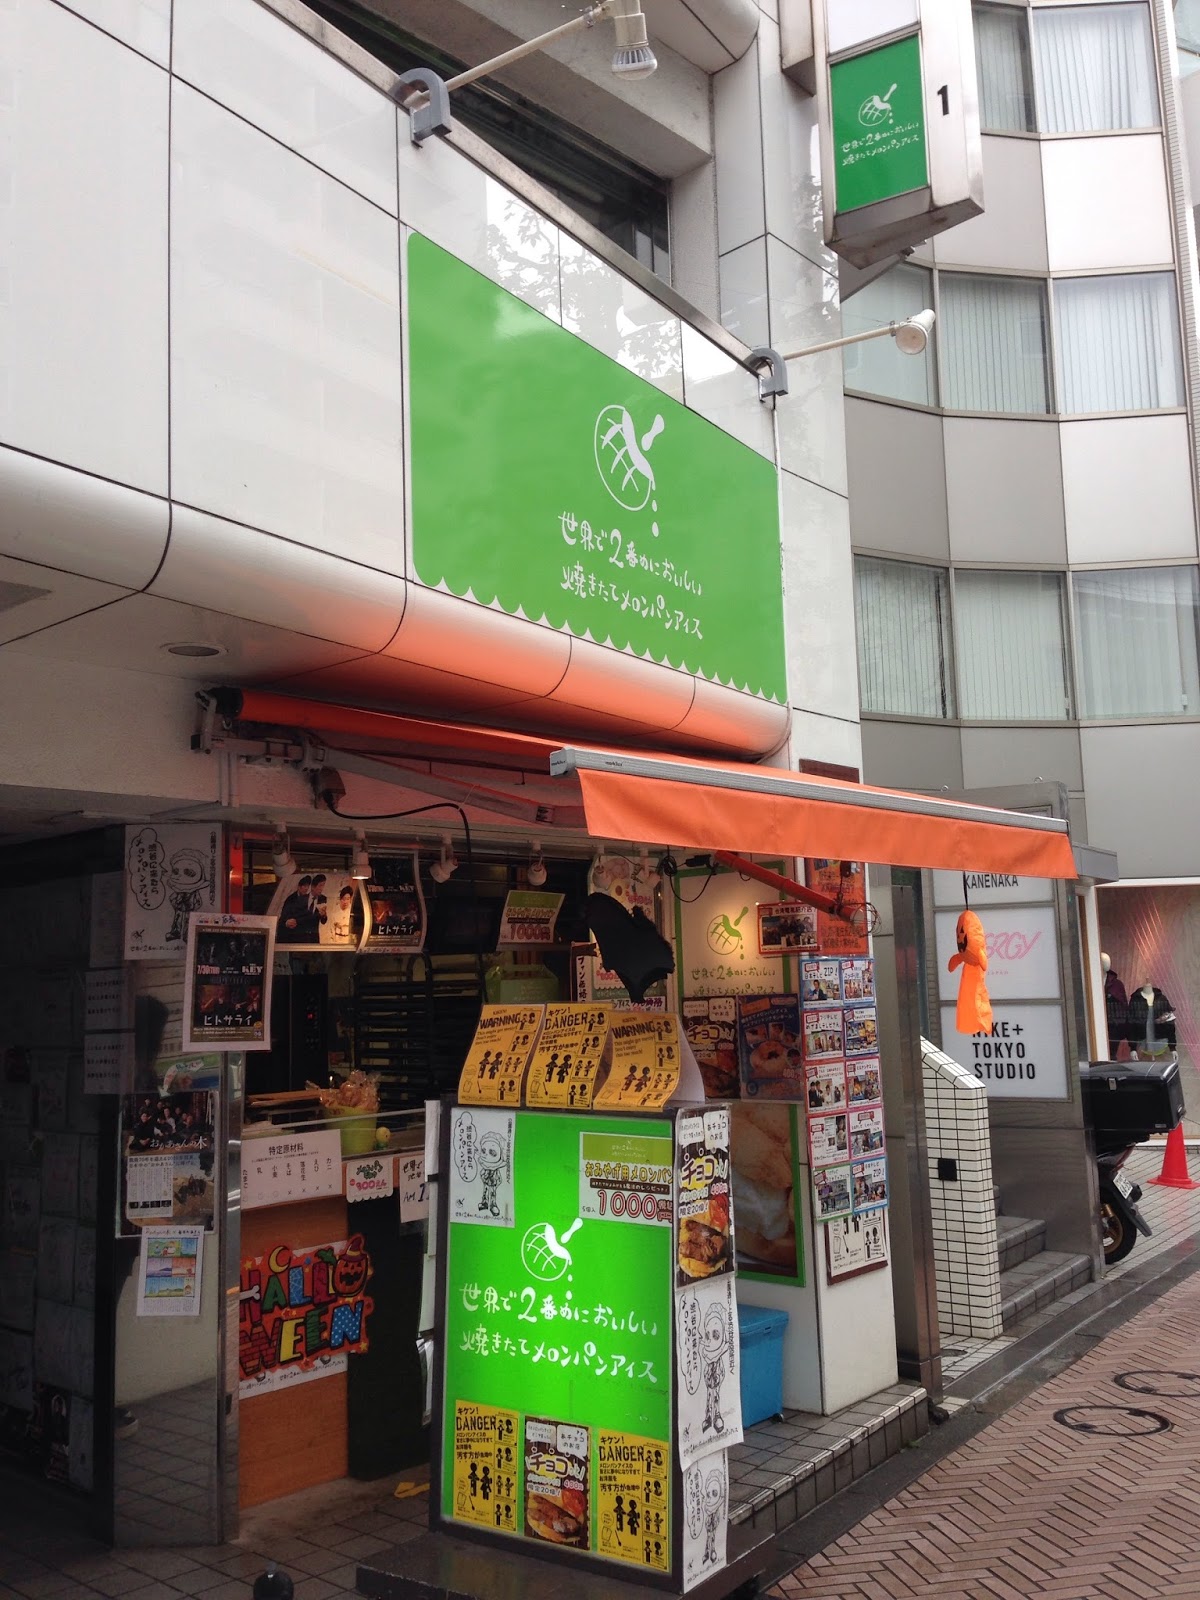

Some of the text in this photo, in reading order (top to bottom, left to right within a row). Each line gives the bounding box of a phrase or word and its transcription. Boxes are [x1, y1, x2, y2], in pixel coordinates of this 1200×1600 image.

[937, 84, 949, 116] 1
[558, 511, 702, 595] 世界で2番めにおいしい
[560, 561, 703, 640] 焼きたてメロンパンアイス
[378, 924, 414, 935] ヒトサライ
[204, 1014, 252, 1026] ヒトサライ
[548, 1007, 571, 1017] キケン!
[480, 1013, 521, 1030] WARNING
[544, 1012, 588, 1031] DANGER
[612, 1021, 656, 1039] WARNING
[972, 1042, 1026, 1059] TOKYO
[974, 1063, 1036, 1080] STUDIO
[150, 1135, 208, 1151] おかあさんの木
[268, 1142, 304, 1156] 特定原材料
[256, 1166, 263, 1175] 乳
[271, 1165, 278, 1179] 小麦
[286, 1162, 292, 1177] そば
[313, 1158, 320, 1172] えび
[326, 1157, 332, 1171] カニ
[585, 1162, 673, 1184] おみやげ用メロンパン
[459, 1282, 657, 1335] 世界で2番めにおいしい
[239, 1300, 364, 1376] WEEN
[459, 1323, 658, 1383] 焼きたてメロンパンアイス
[457, 1407, 479, 1415] キケン!
[456, 1415, 497, 1431] DANGER
[600, 1436, 625, 1445] キケン!
[599, 1445, 644, 1462] DANGER
